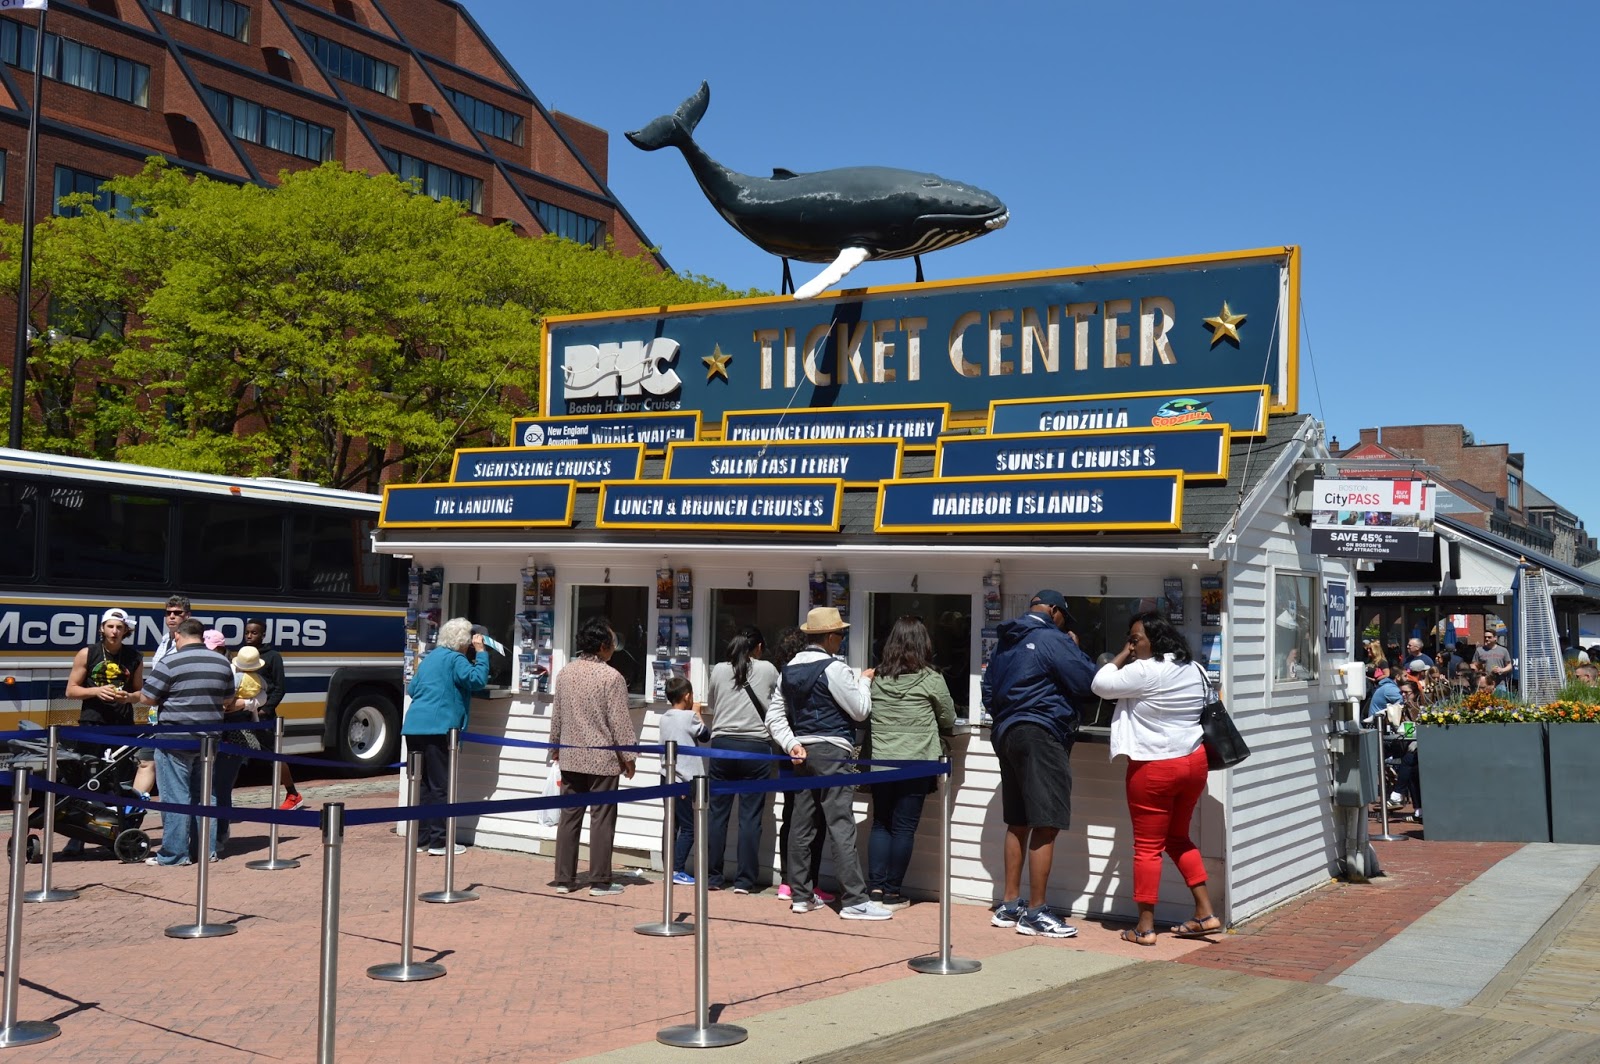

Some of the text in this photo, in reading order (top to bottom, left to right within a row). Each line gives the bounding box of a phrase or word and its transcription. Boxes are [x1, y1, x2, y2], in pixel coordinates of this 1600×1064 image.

[753, 296, 1178, 390] TICKET CENTER
[563, 337, 682, 399] BHC
[569, 398, 681, 414] Boston Harbor Cruises
[1039, 408, 1128, 431] CODZILLA
[1151, 412, 1213, 427] CODZILLA
[547, 425, 589, 436] New England
[591, 425, 686, 444] WHALE WATCH
[732, 418, 935, 441] PROVINCETOWN FAST FERRY
[547, 437, 579, 446] Aquarium
[709, 454, 850, 474] SALEM FAST FERRY
[996, 444, 1156, 471] SUNSET CRUISES
[473, 458, 612, 477] SIGHTSEEING CRUISES
[434, 494, 514, 514] THE LANDING
[613, 494, 825, 517] LUNCH & BRUNCH CRUISES
[932, 489, 1104, 515] HARBOR ISLANDS
[1324, 493, 1380, 507] CityPASS
[1330, 532, 1383, 542] SAVE 45%
[476, 566, 481, 581] 1
[604, 568, 610, 583] 2
[747, 571, 754, 588] 3
[910, 574, 919, 592] 4
[1100, 576, 1108, 595] 5
[1330, 594, 1337, 608] 24
[0, 611, 166, 646] McGIN
[1330, 616, 1345, 638] ATM
